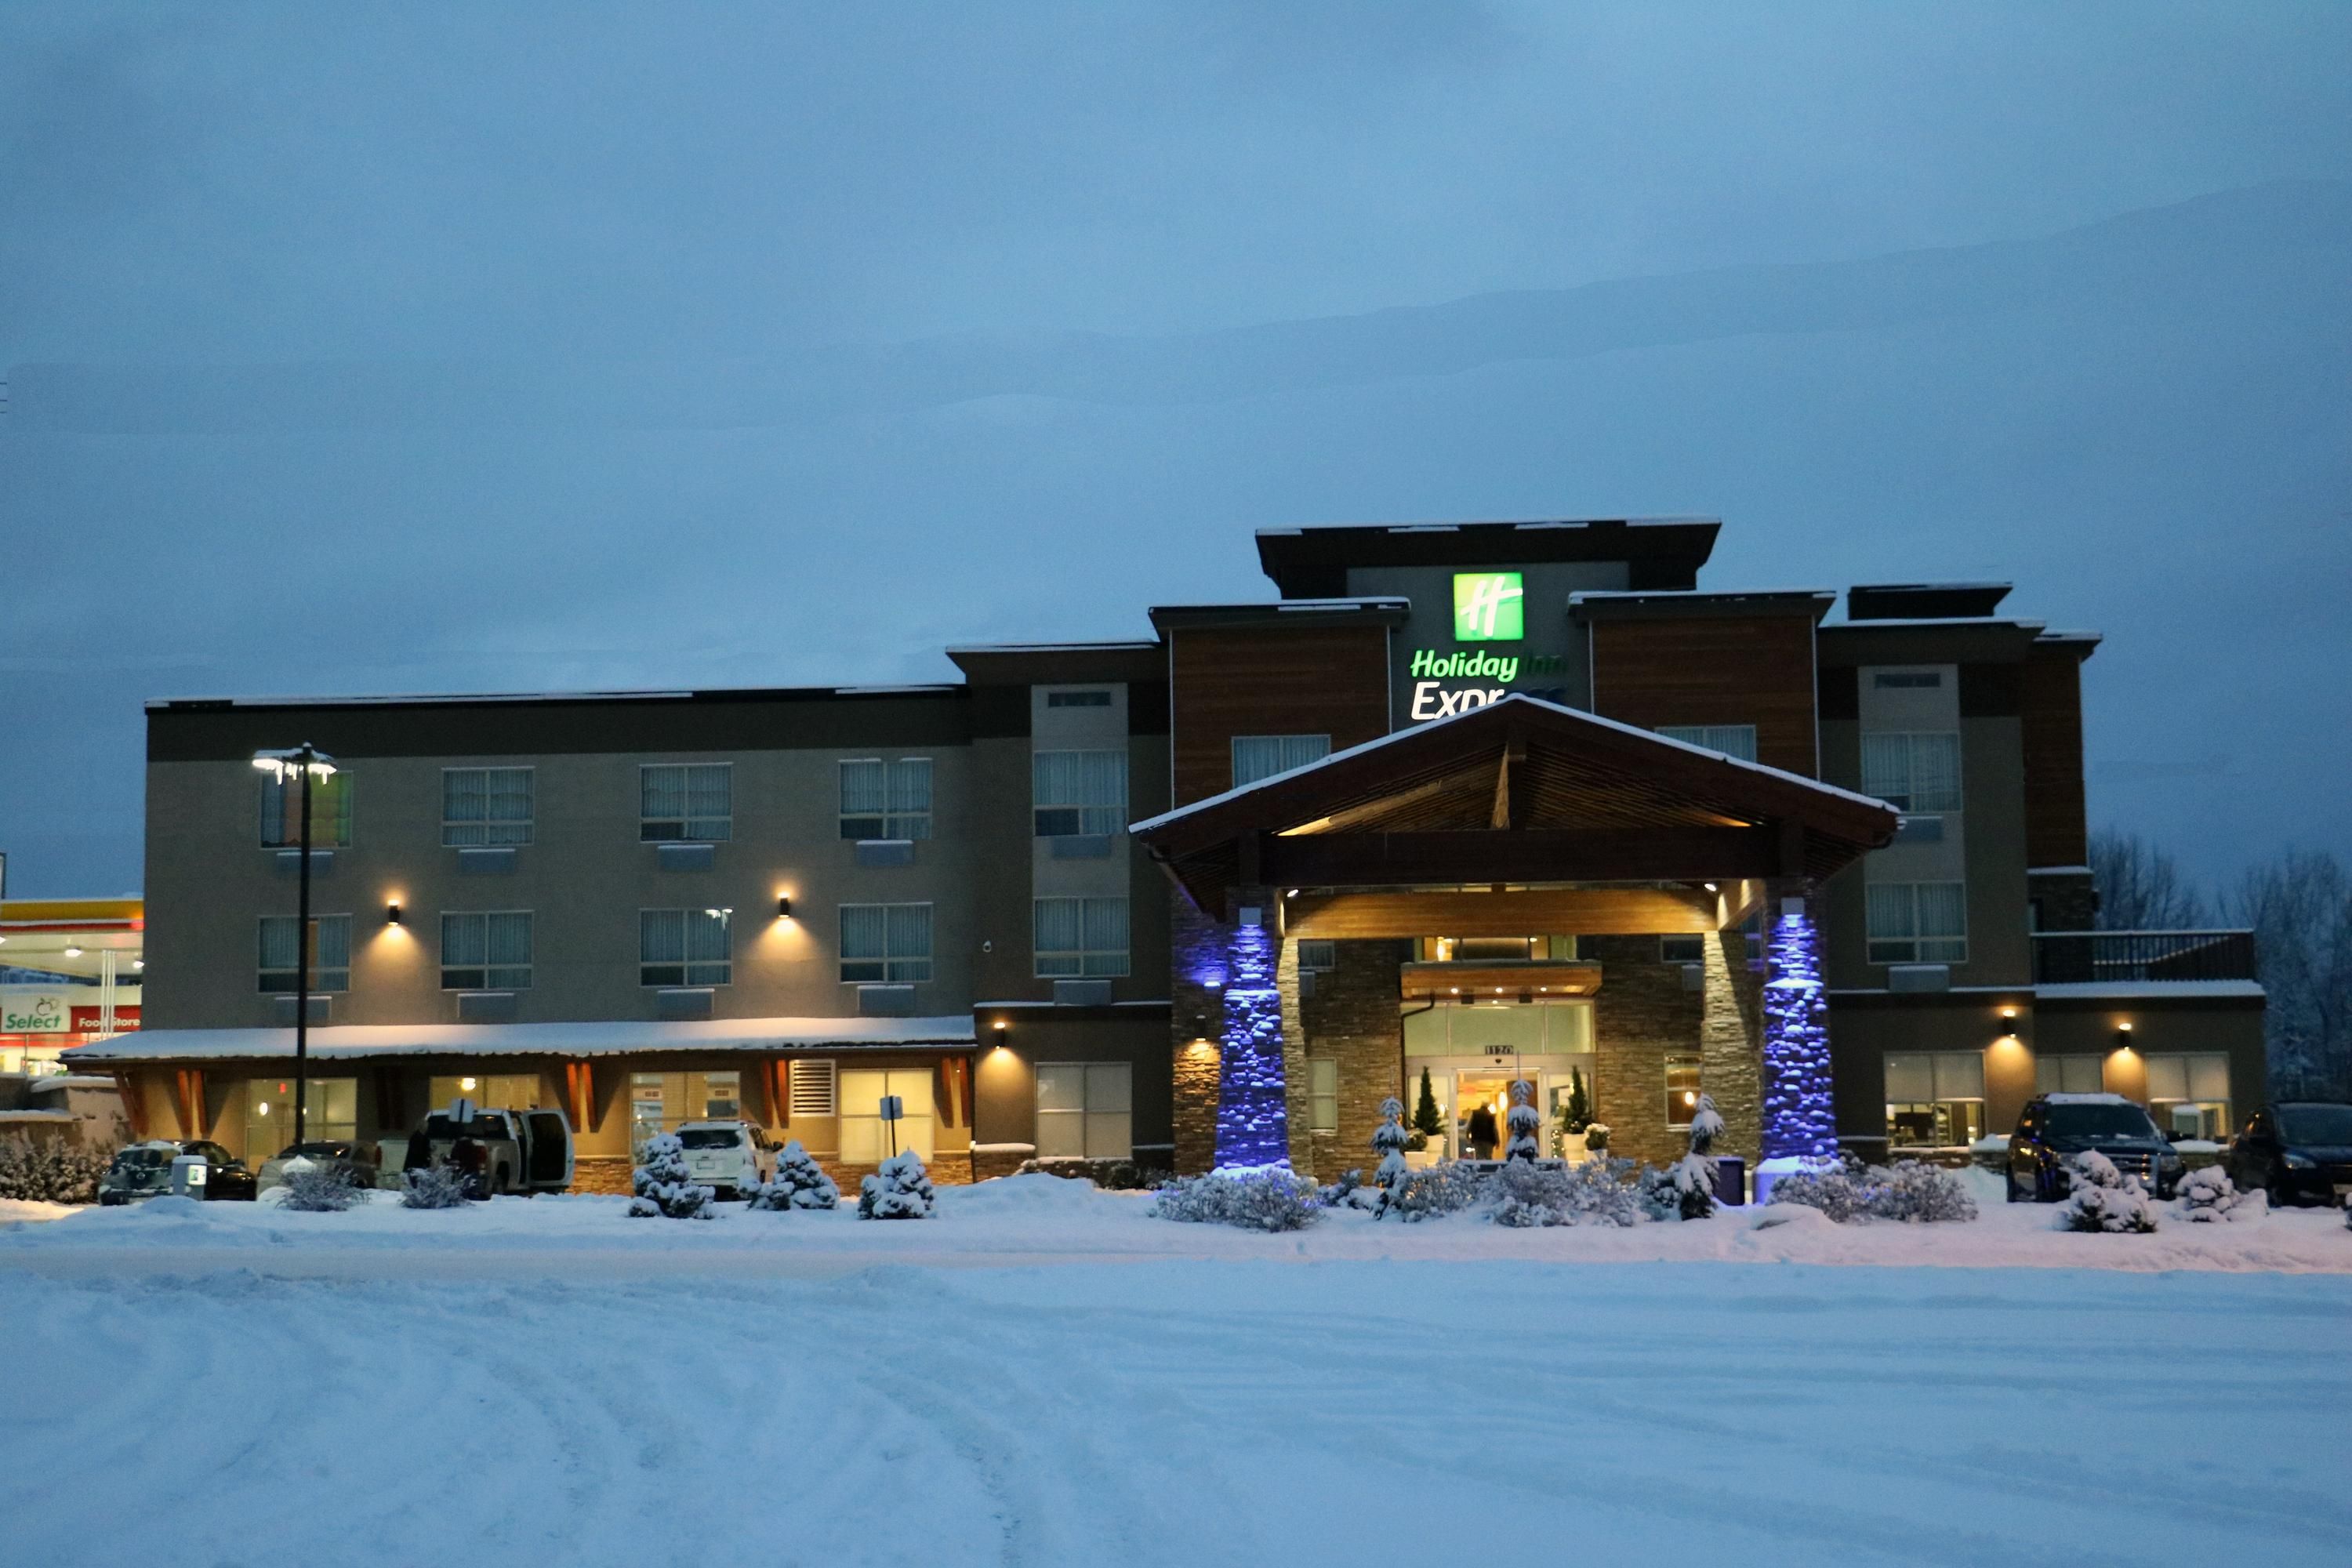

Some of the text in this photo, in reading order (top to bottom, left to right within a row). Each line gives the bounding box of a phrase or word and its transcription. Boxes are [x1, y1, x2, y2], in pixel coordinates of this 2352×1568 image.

[1410, 650, 1518, 682] Holiday
[5, 1013, 61, 1029] Select
[79, 1017, 108, 1027] Foo
[1486, 1046, 1513, 1054] 1120
